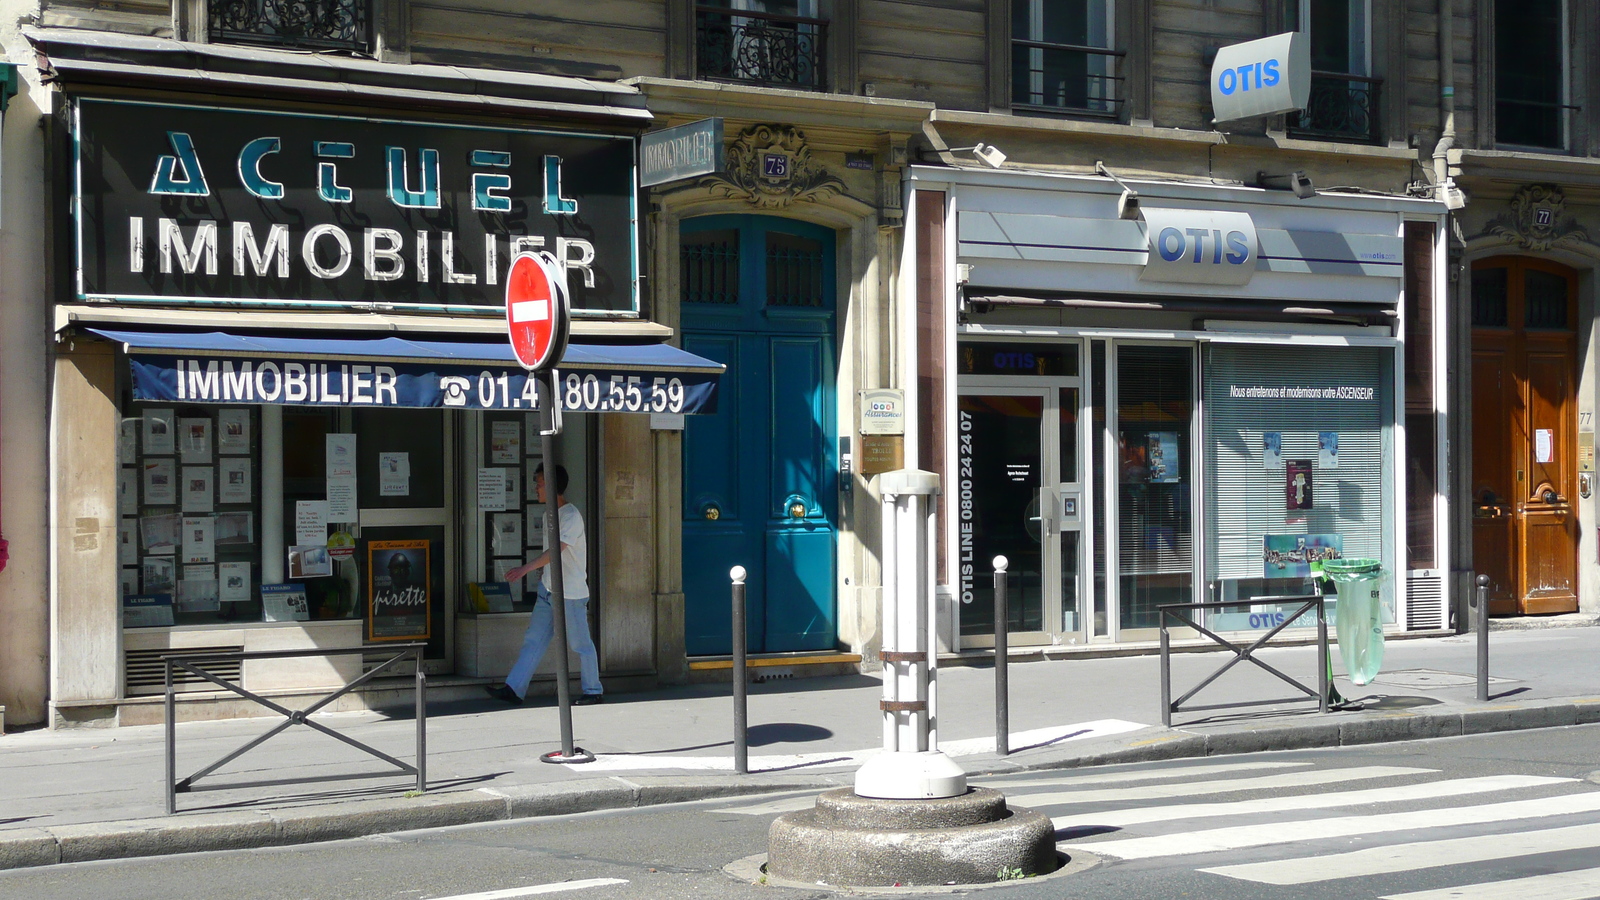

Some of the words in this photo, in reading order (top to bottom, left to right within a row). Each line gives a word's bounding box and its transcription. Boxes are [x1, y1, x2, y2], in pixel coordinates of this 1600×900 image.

[1218, 58, 1280, 96] OTIS
[148, 131, 579, 215] ACTUEL
[767, 157, 786, 176] 75
[1539, 210, 1550, 224] 77
[1157, 226, 1250, 265] OTIS
[993, 352, 1036, 369] OTIS
[176, 358, 399, 405] IMMOBILIER
[477, 370, 685, 413] 01.4.80.55.59
[1230, 384, 1246, 398] Nous
[1246, 385, 1279, 399] entretenons
[1280, 386, 1286, 399] et
[1286, 385, 1322, 399] modernisons
[1322, 387, 1336, 399] votre
[1336, 386, 1374, 400] ASCENSEUR
[960, 410, 973, 432] 07
[1579, 412, 1593, 425] 77
[960, 433, 973, 455] 24
[960, 456, 973, 478] 24
[960, 479, 974, 520] 0800
[961, 521, 974, 562] LINE
[961, 564, 974, 604] OTIS
[1248, 612, 1286, 629] OTIS
